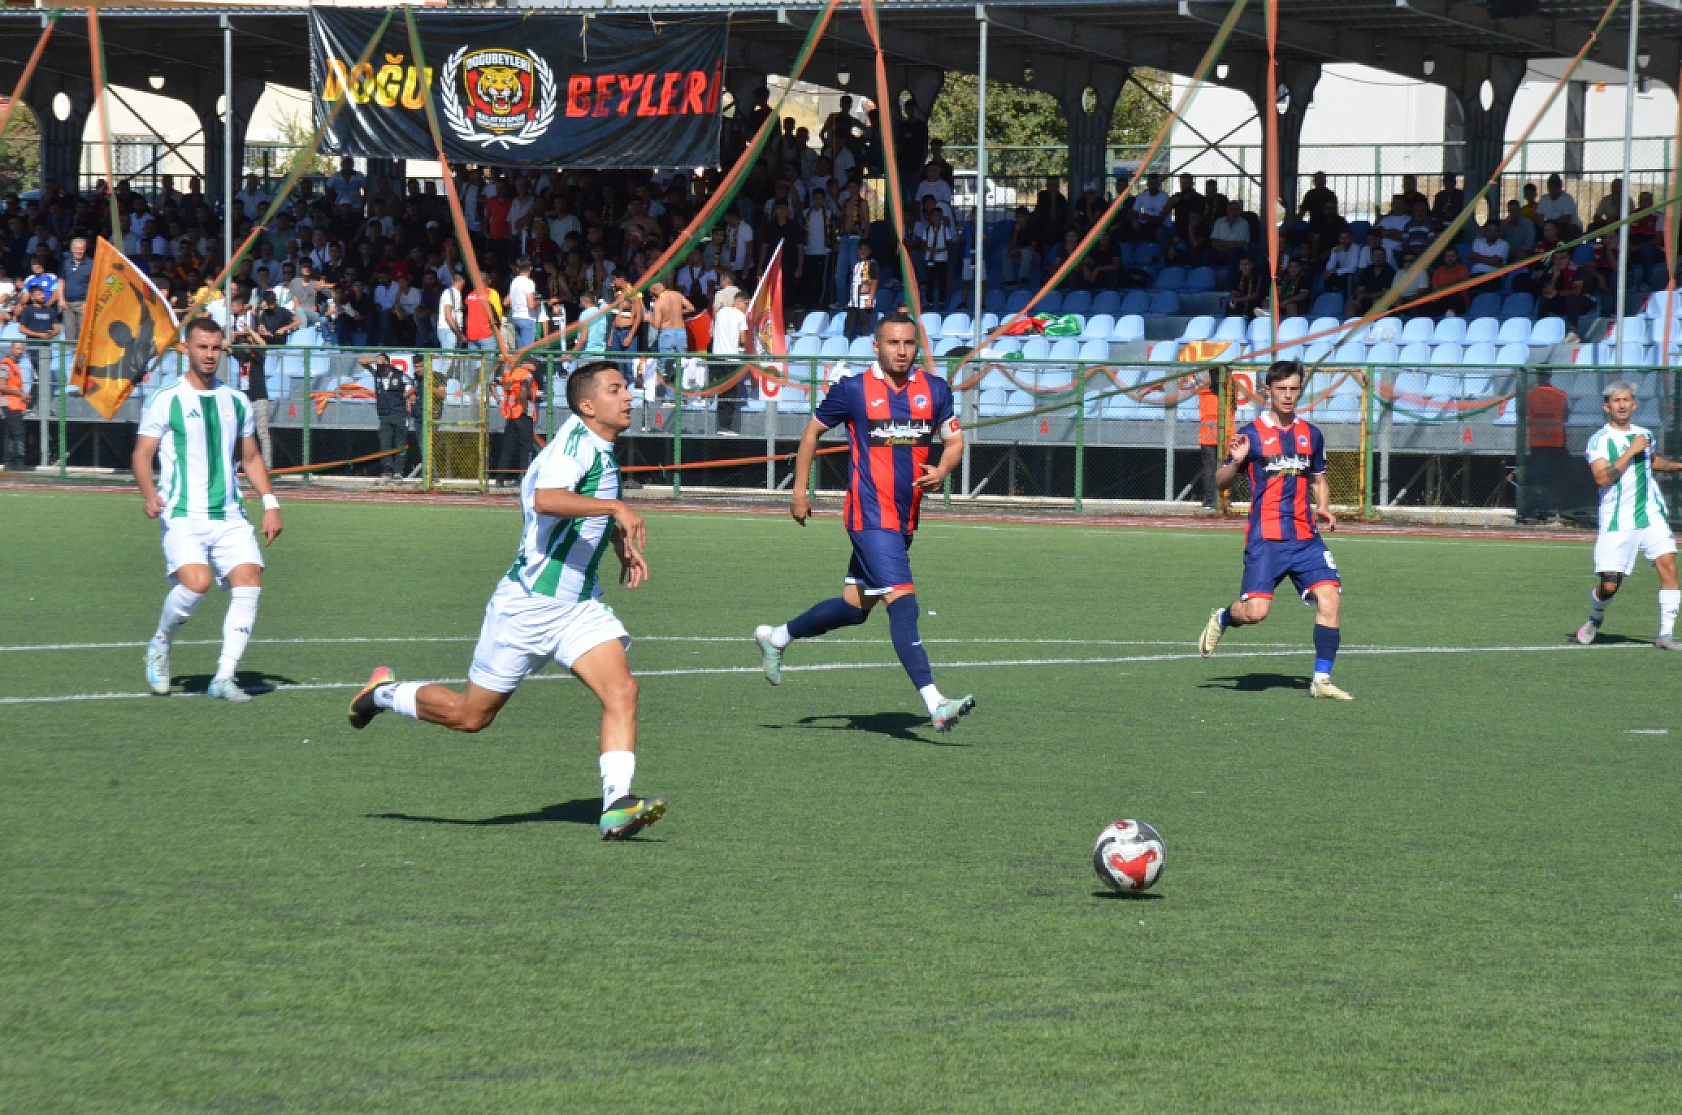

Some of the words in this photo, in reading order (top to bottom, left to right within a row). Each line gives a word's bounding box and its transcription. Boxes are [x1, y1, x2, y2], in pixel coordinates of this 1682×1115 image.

[321, 53, 433, 109] DOĞU
[565, 60, 723, 118] BEYLERİ
[287, 403, 297, 418] A
[654, 411, 664, 426] A
[1039, 420, 1049, 434] A
[1462, 427, 1473, 442] A
